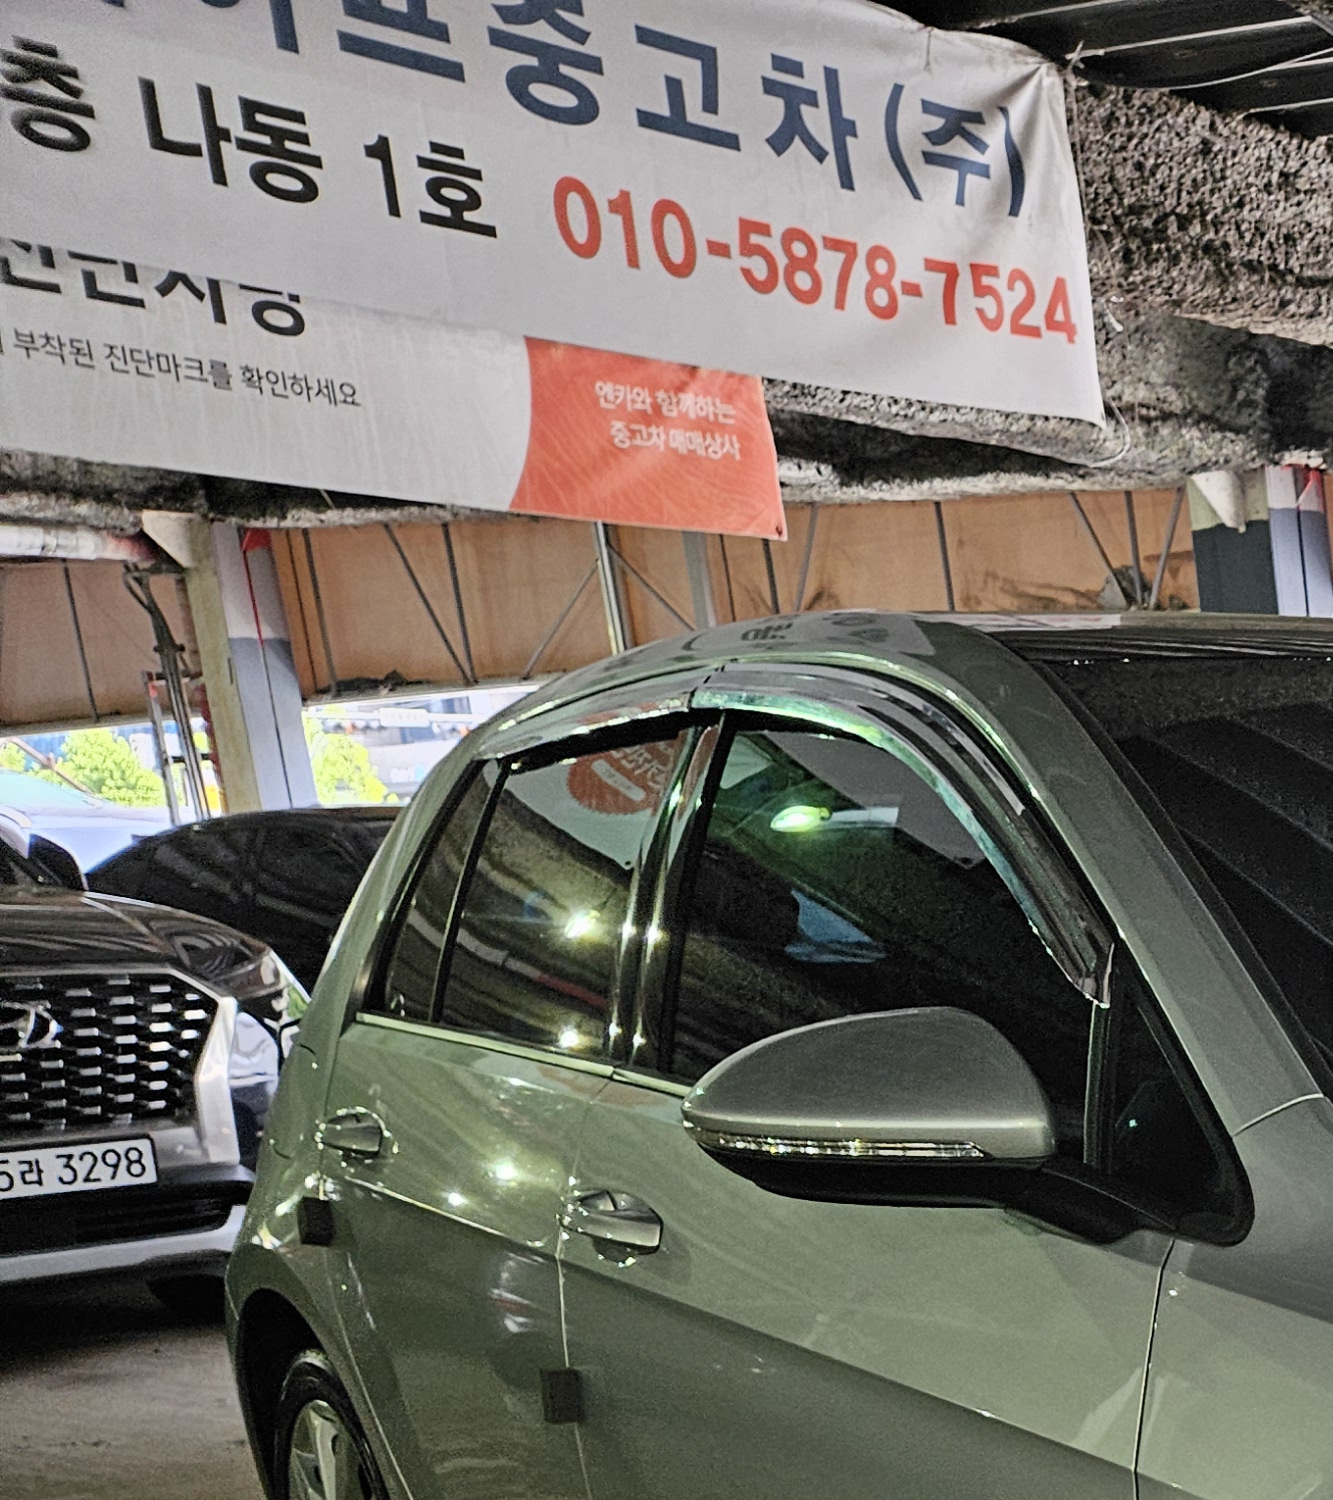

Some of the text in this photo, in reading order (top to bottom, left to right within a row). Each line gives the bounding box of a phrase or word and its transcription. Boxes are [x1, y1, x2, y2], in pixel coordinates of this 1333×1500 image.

[0, 34, 1078, 344] 층 나동 1호 010-5878-7524
[13, 328, 95, 369] 부착된
[239, 364, 362, 407] 확인하세요
[594, 381, 736, 425] 엔카와 함께하는
[610, 419, 741, 461] 중고차 매매상사
[55, 1147, 146, 1185] 3298
